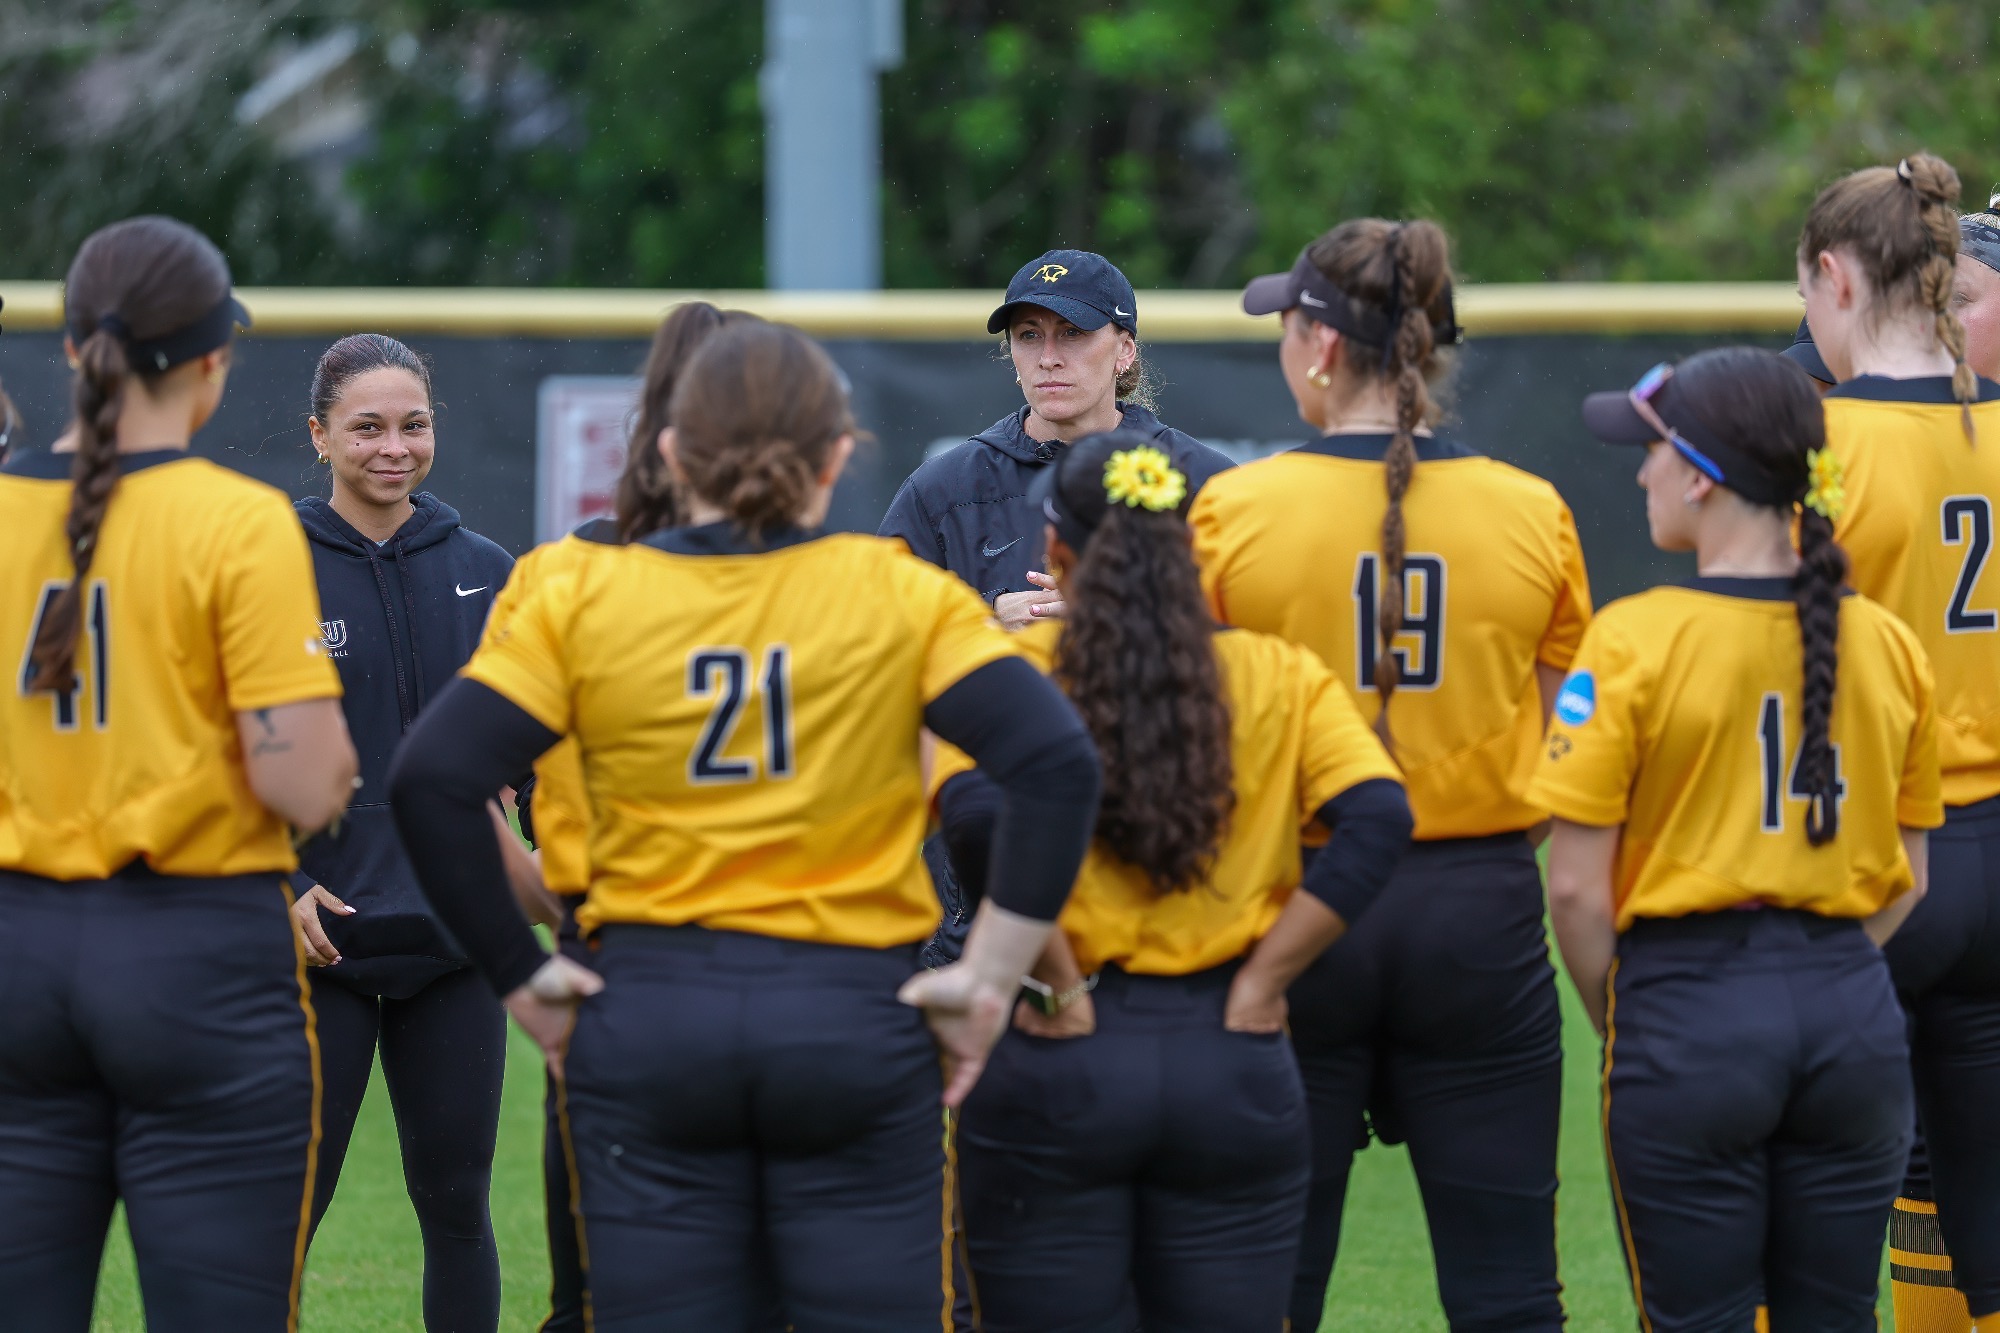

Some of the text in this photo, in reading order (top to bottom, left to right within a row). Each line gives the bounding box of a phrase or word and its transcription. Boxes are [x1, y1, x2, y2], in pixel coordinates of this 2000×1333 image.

[1352, 552, 1447, 692] 19
[1940, 494, 1998, 634] 2
[685, 643, 796, 786] 21
